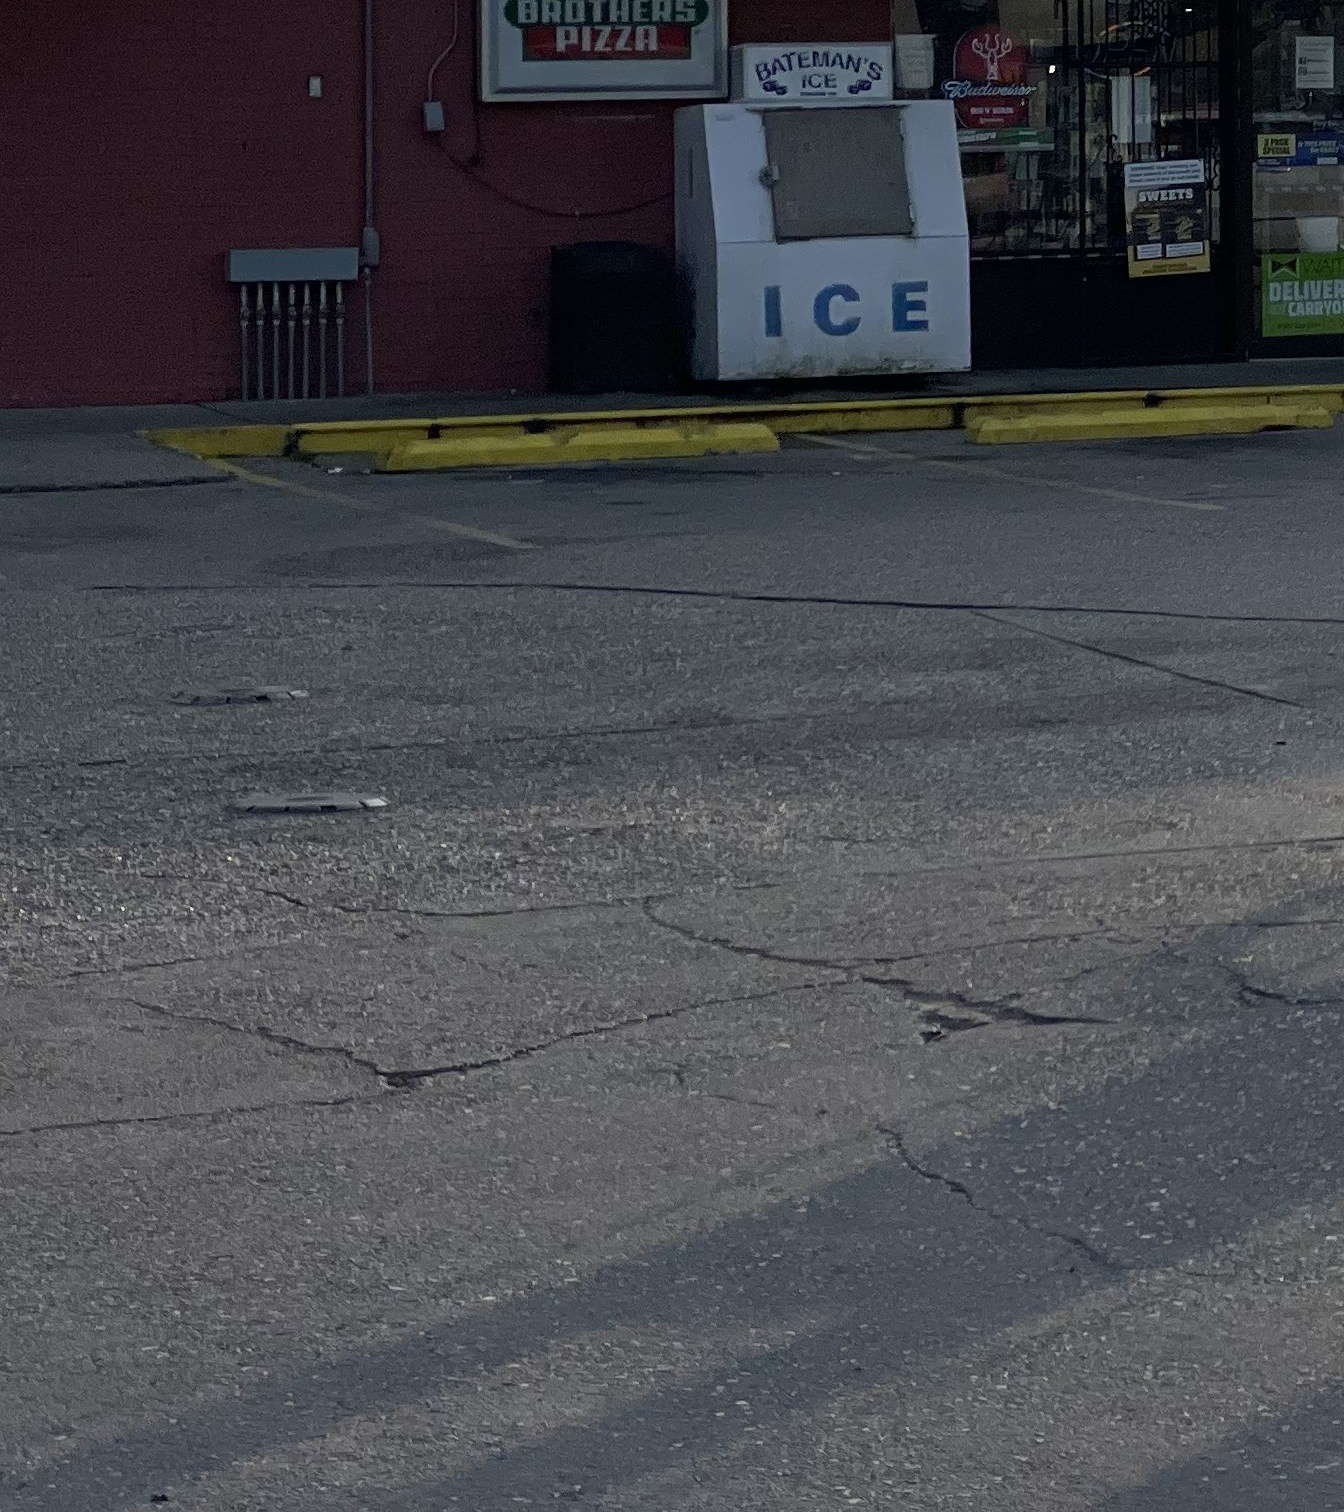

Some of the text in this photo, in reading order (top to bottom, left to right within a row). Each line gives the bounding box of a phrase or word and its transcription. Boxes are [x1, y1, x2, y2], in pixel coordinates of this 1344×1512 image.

[517, 0, 697, 24] BROTHERS
[556, 25, 659, 53] PIZZA
[755, 51, 884, 81] BATEMAN'S
[801, 73, 838, 89] ICE
[1138, 187, 1194, 202] SWEETS
[763, 280, 930, 339] ICE
